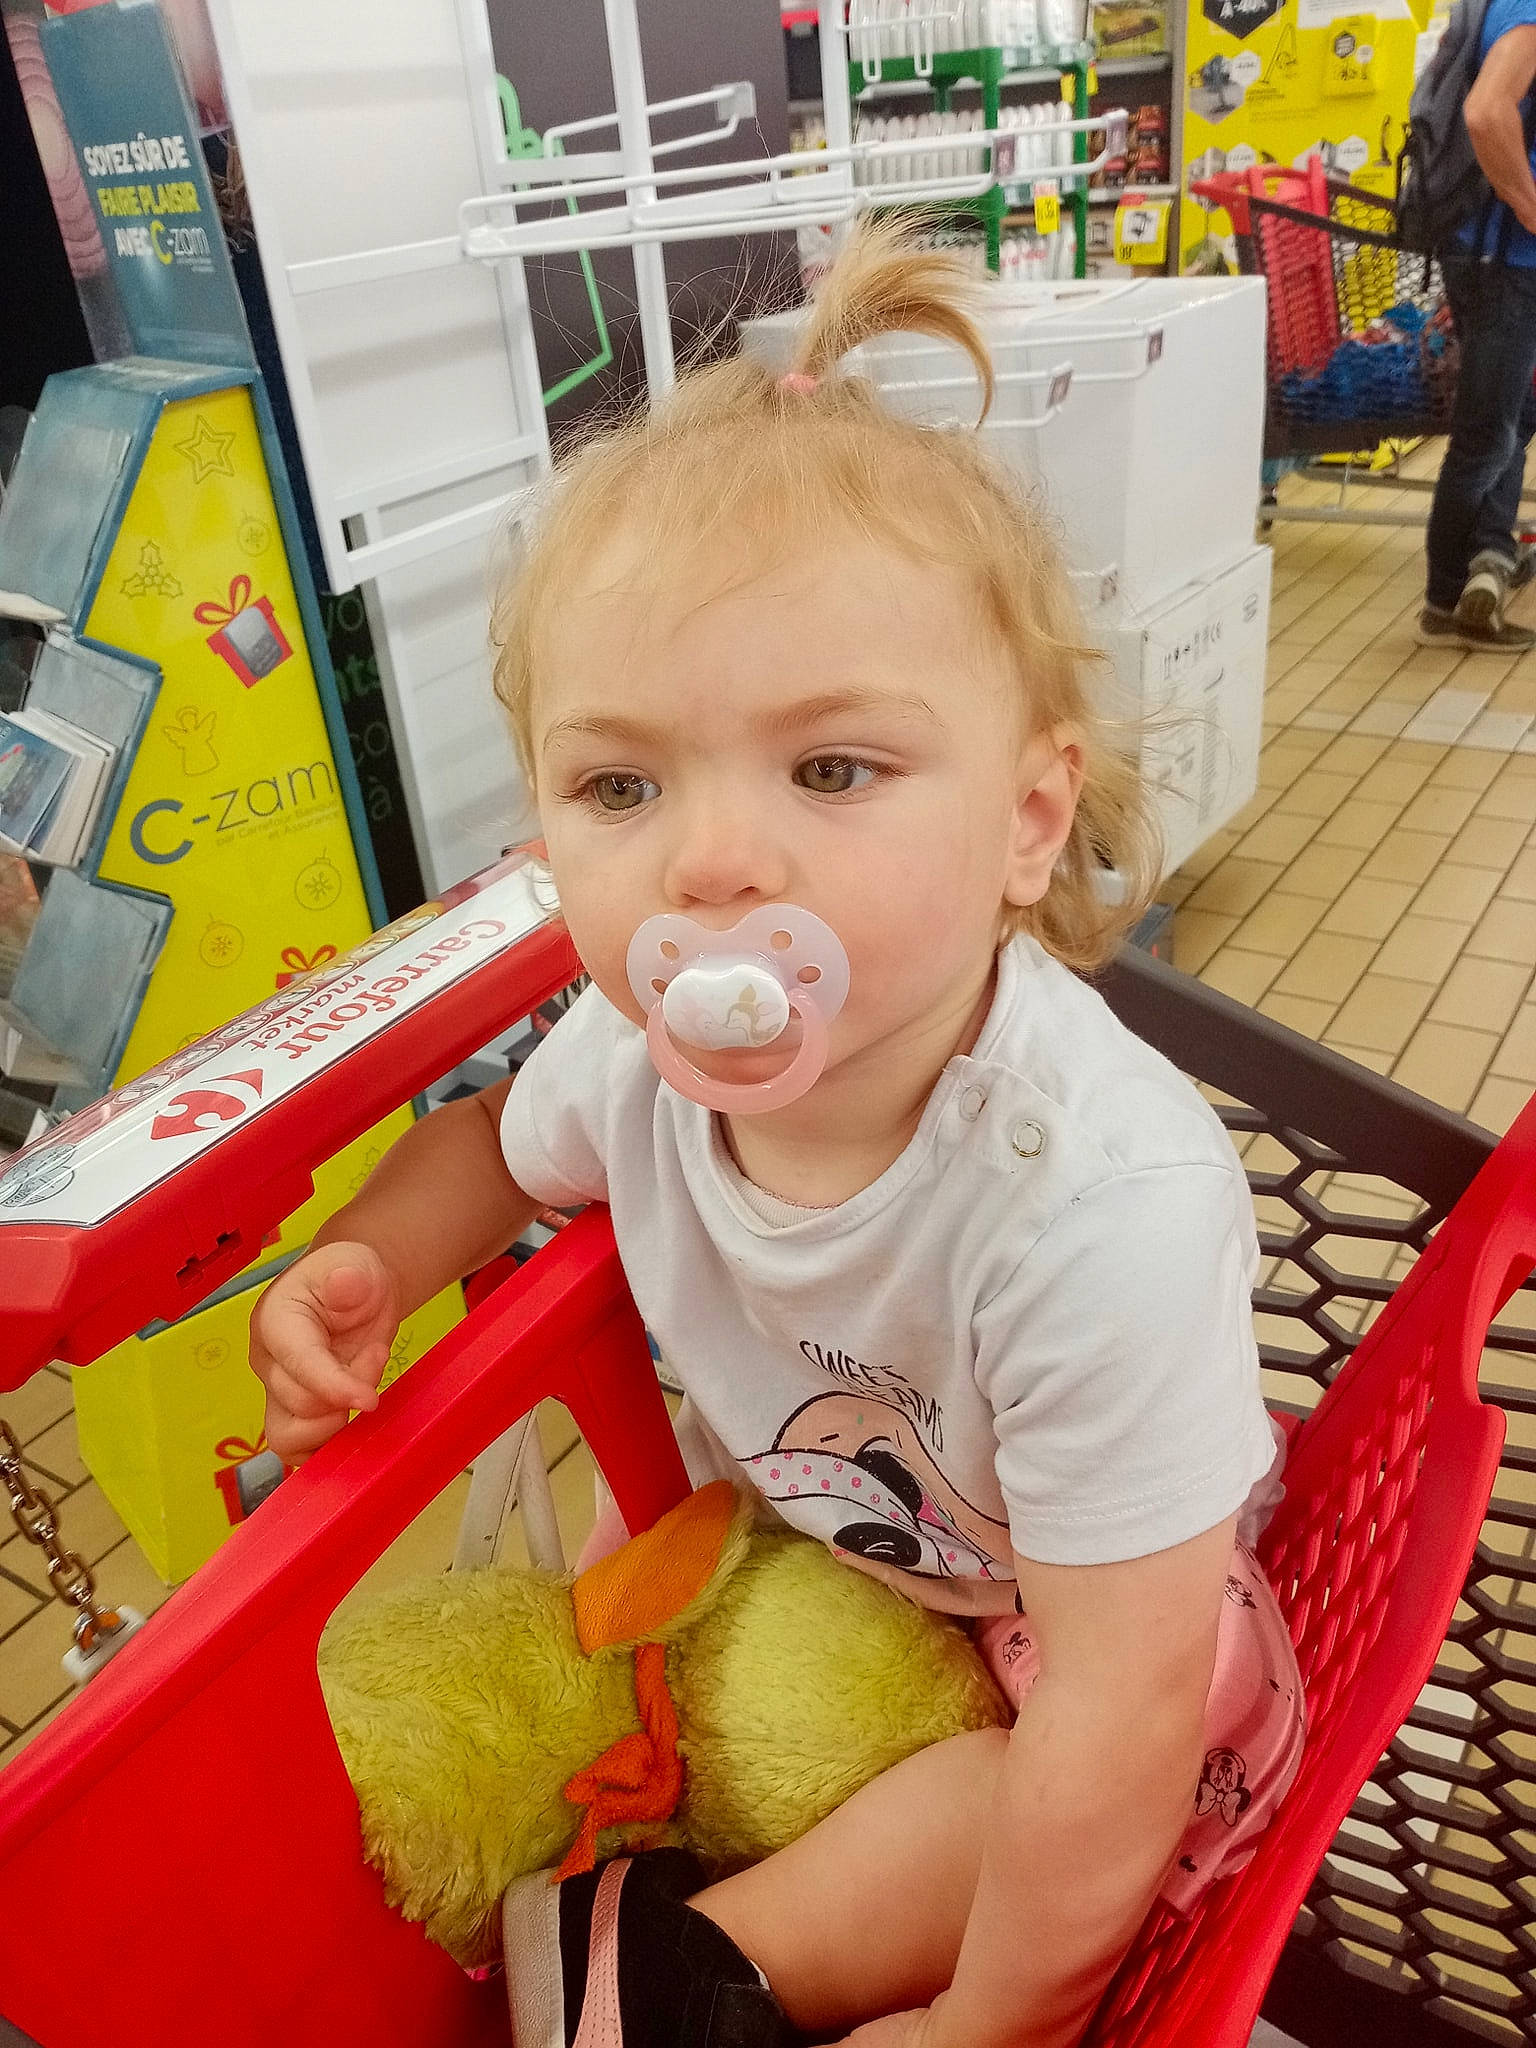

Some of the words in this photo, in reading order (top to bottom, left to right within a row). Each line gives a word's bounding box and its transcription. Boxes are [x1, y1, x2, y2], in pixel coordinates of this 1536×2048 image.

[160, 135, 192, 170] DE
[129, 761, 335, 865] C-zam
[240, 974, 366, 1052] market
[274, 919, 507, 1060] Carrefour
